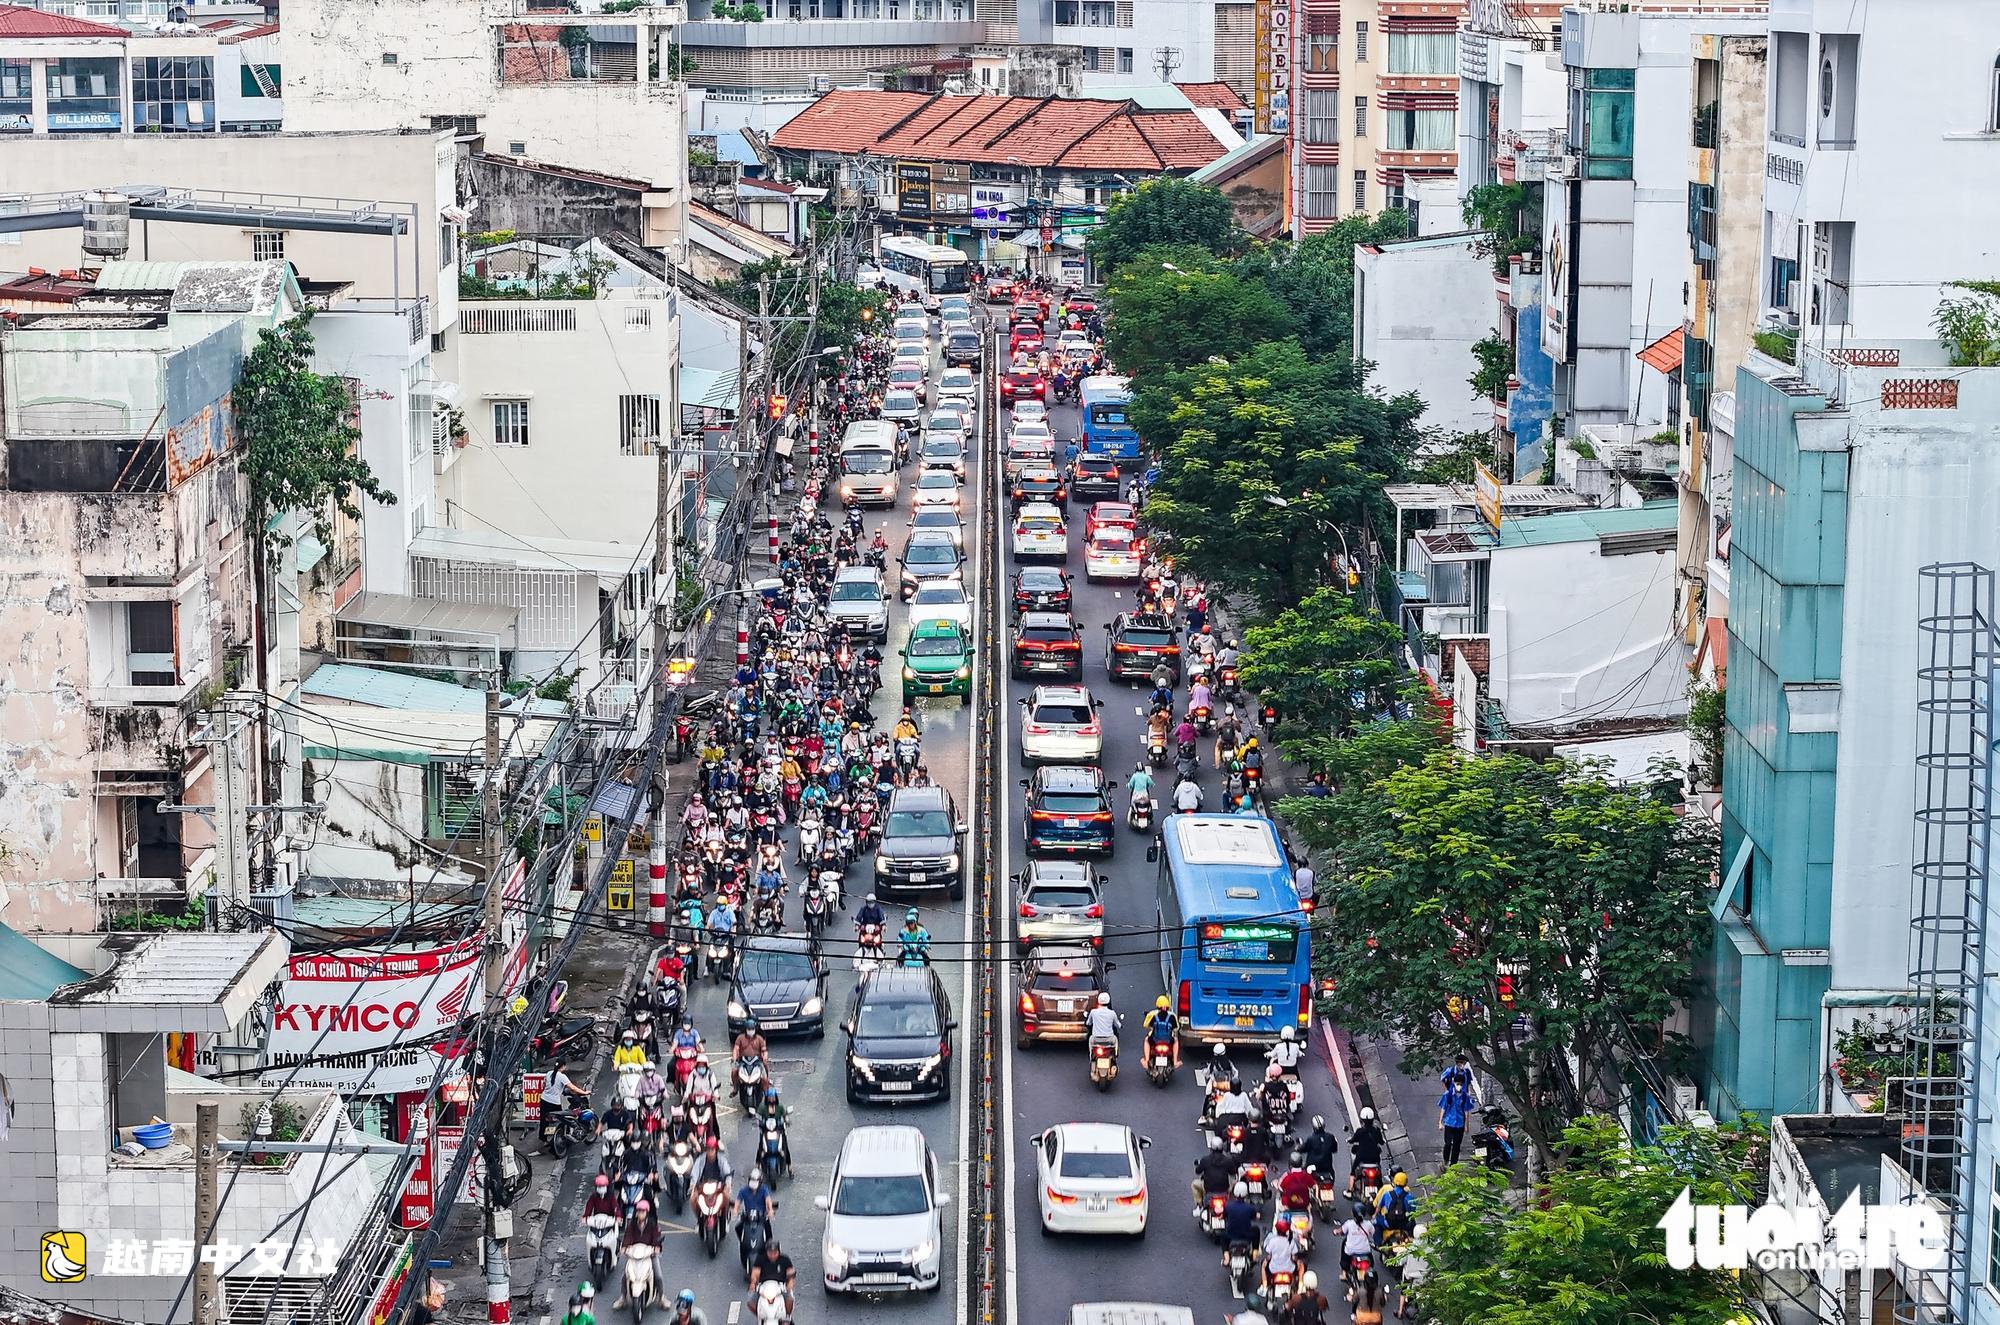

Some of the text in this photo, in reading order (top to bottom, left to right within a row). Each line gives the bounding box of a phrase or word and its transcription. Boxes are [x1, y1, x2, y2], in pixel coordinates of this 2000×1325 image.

[55, 114, 112, 124] BILLIARDS
[585, 822, 599, 831] XAY
[1207, 926, 1220, 937] 20
[274, 1000, 421, 1033] KYMCO
[436, 1009, 472, 1026] HONA
[337, 1080, 357, 1090] P.13
[524, 1079, 540, 1090] THAY
[525, 1106, 541, 1119] BỌC
[406, 1205, 429, 1221] TRUNG
